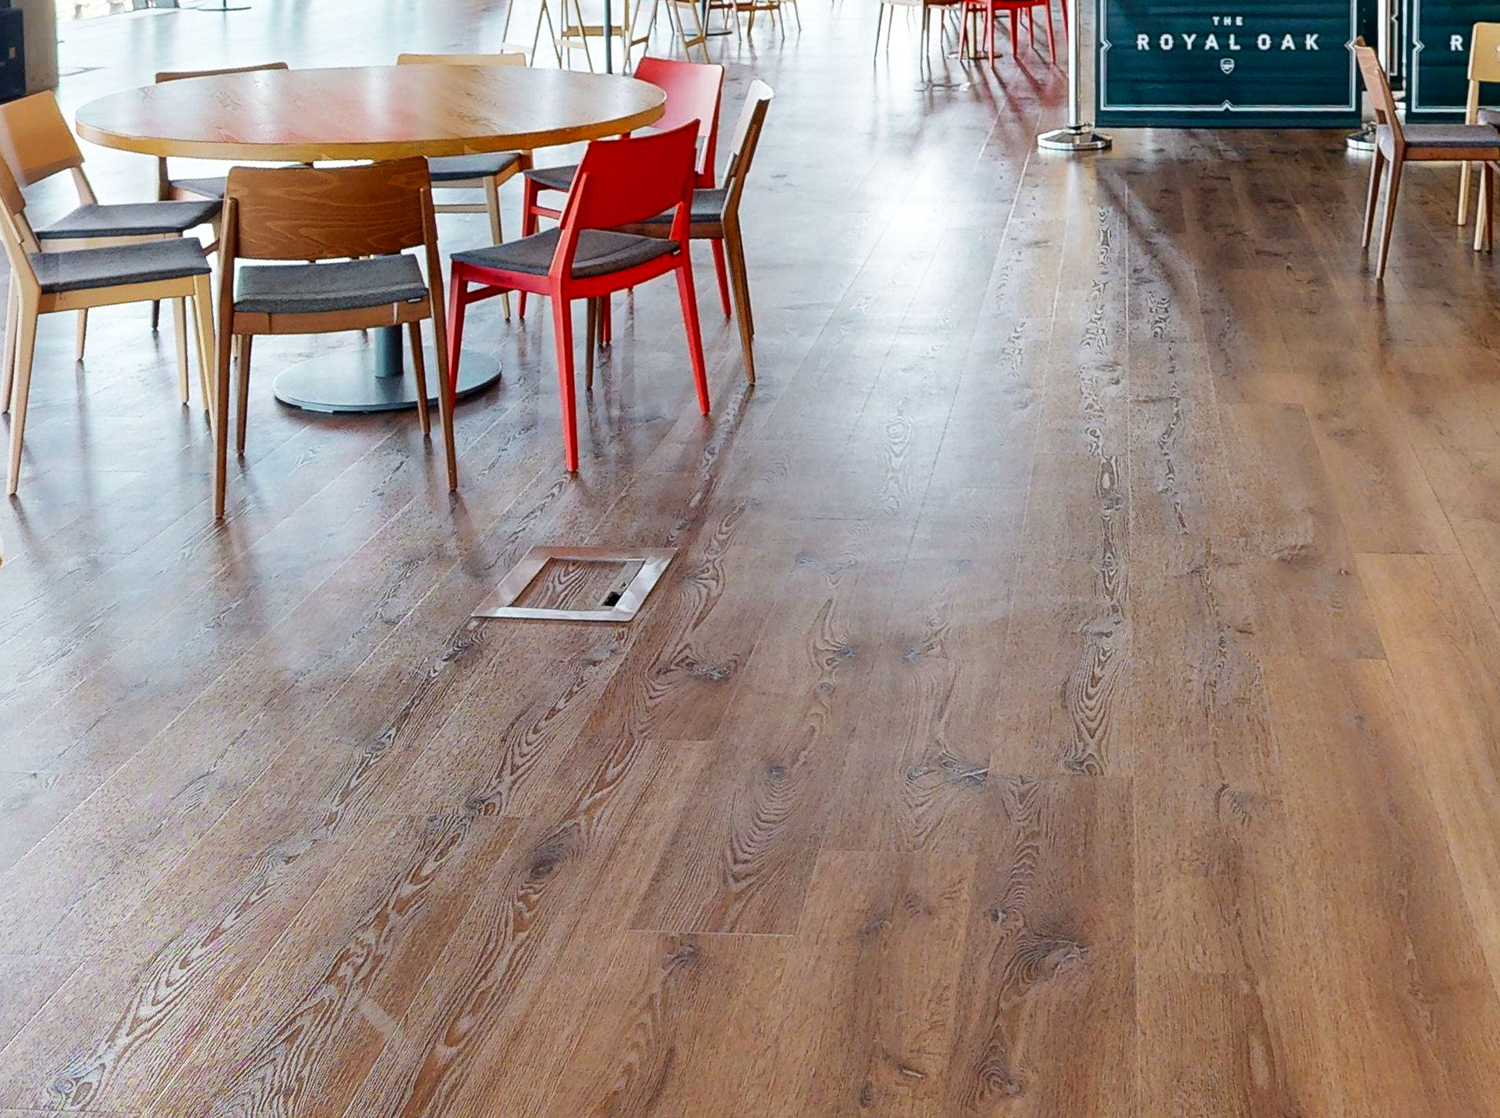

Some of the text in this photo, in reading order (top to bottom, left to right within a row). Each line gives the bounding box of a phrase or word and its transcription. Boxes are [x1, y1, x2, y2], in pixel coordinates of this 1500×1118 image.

[1212, 16, 1244, 26] THE
[1136, 34, 1320, 51] ROYAL OAK
